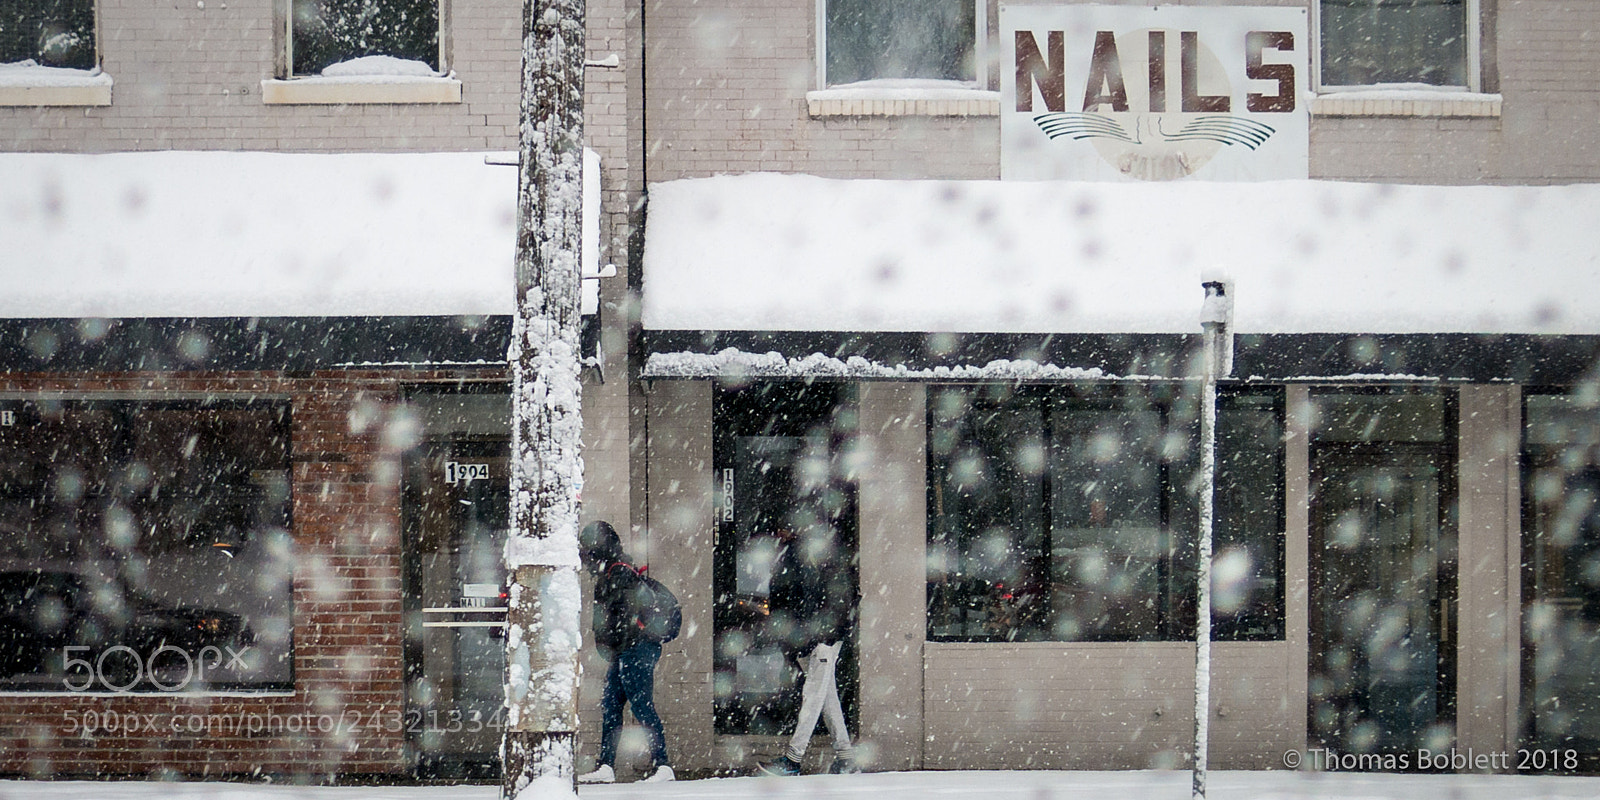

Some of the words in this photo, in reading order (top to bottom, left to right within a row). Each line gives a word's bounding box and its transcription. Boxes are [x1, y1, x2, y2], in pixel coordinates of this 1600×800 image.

[1015, 31, 1295, 112] NAILS
[447, 462, 488, 482] 1904
[724, 469, 733, 521] 1902
